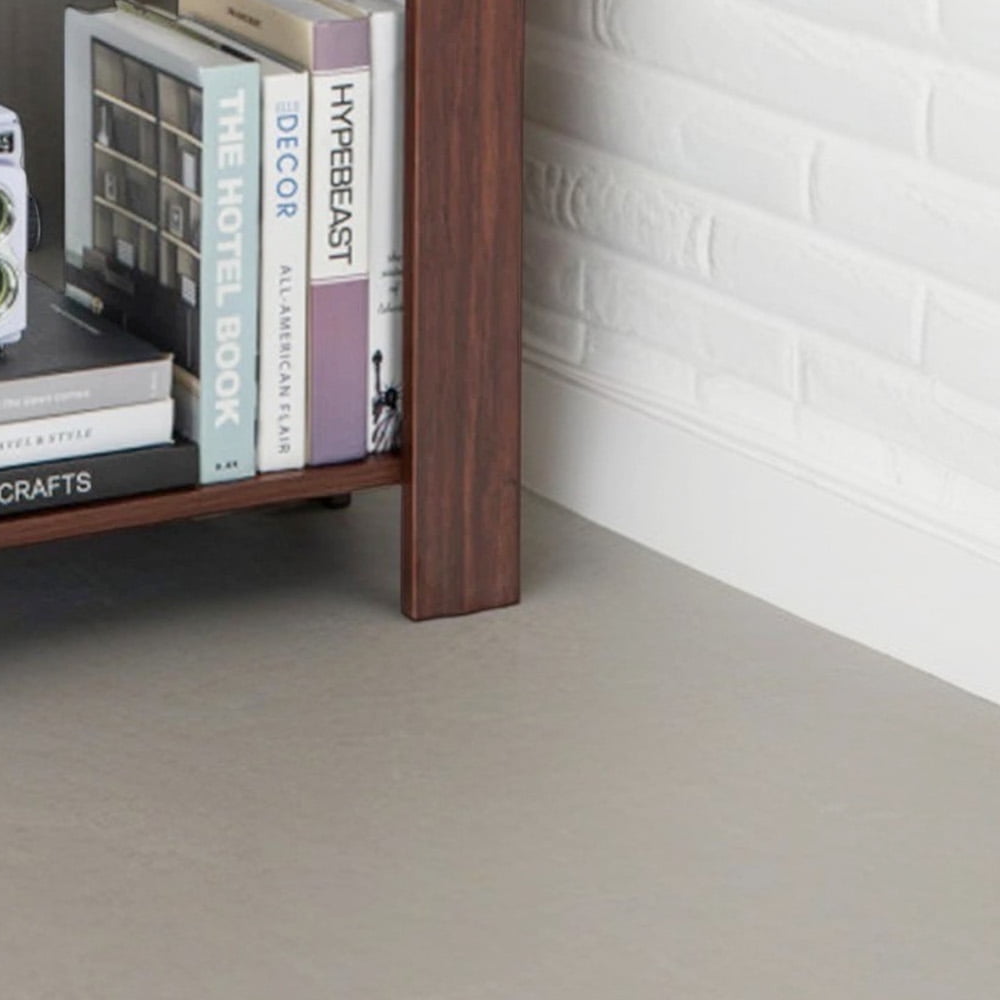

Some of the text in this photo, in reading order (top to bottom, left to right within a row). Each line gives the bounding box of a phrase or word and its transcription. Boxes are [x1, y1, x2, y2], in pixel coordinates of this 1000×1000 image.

[217, 88, 245, 169] THE
[276, 114, 299, 218] DECOR
[328, 83, 354, 265] HYPEBEAST
[215, 177, 244, 307] HOTEL
[214, 315, 241, 429] BOOK
[277, 264, 292, 455] ALL-AMERICAN FLAIR
[48, 427, 93, 445] STYLE
